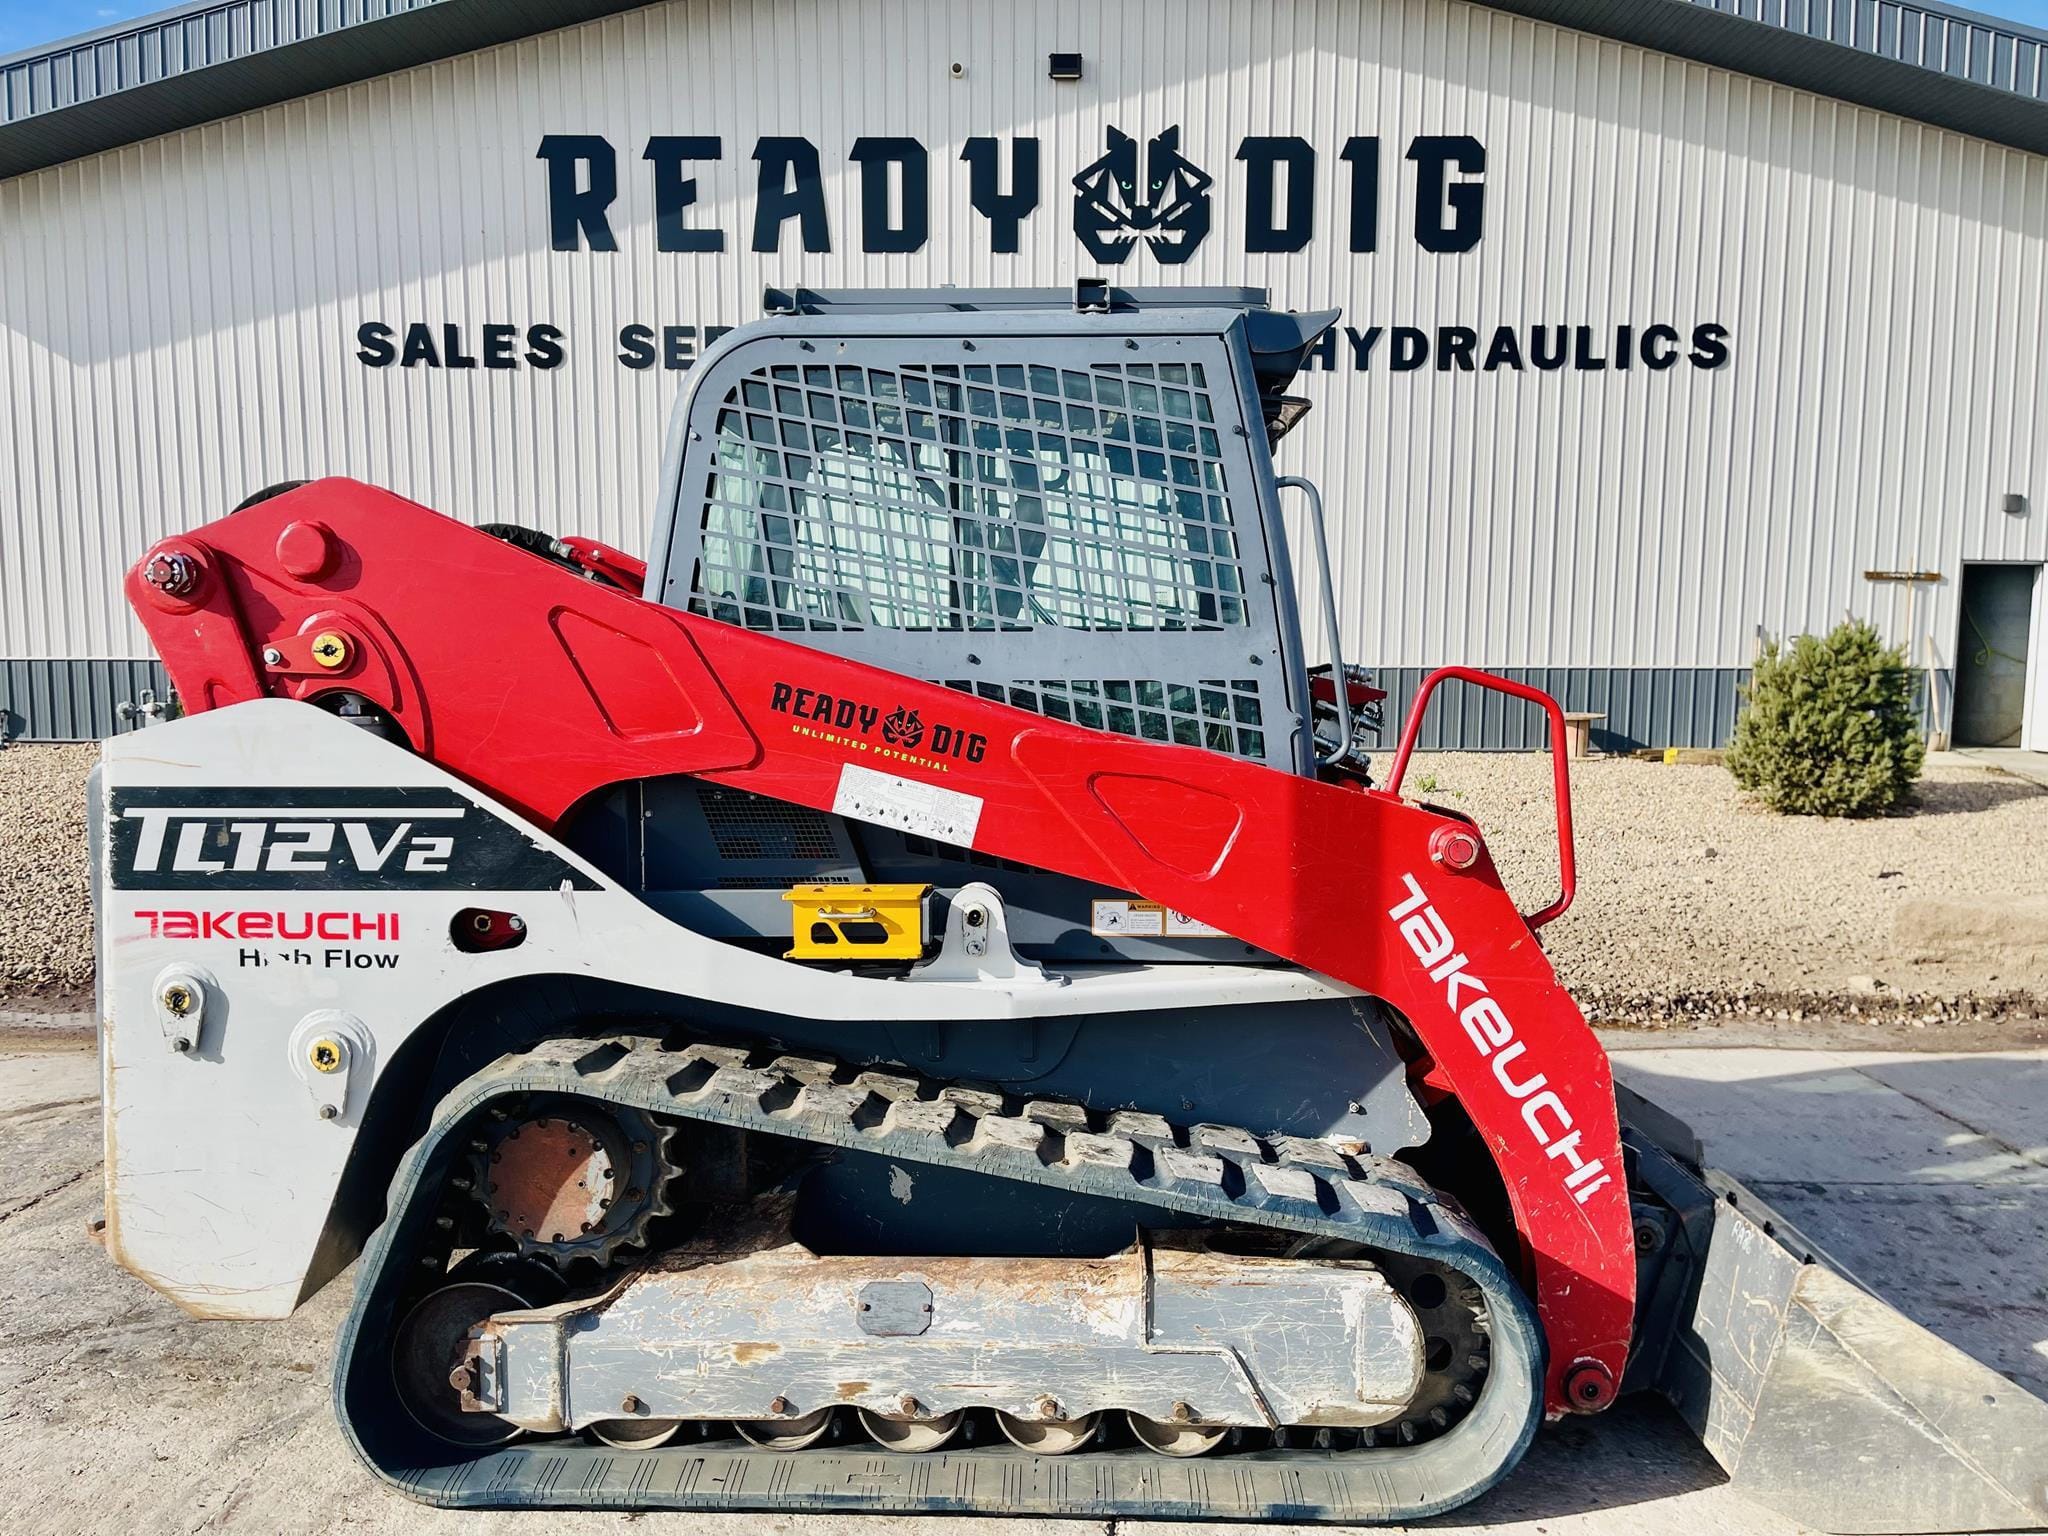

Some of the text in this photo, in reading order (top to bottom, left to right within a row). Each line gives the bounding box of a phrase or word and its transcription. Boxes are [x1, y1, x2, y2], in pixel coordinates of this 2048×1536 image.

[536, 135, 1485, 253] READY DIG
[357, 322, 563, 370] SALES
[1299, 324, 1729, 371] HYDRAULICS
[771, 682, 987, 763] READY DIG
[792, 725, 949, 772] UNLIMITED POTENTIAL
[123, 808, 465, 872] TL12V2
[239, 949, 399, 969] Hh Flow
